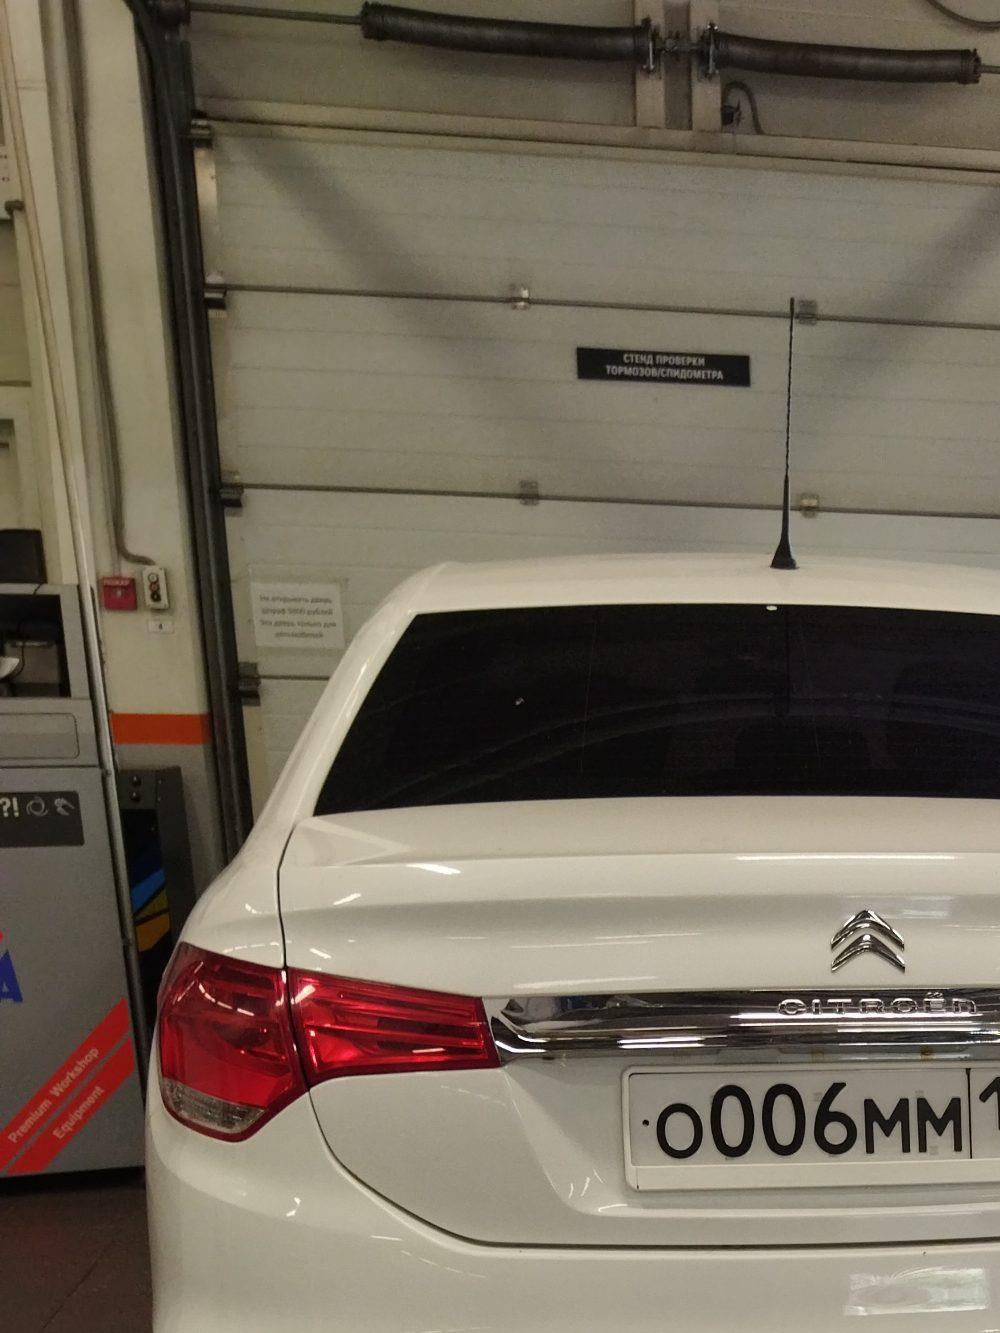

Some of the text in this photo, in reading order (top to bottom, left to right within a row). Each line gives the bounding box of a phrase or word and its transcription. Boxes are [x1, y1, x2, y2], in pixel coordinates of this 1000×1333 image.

[606, 365, 724, 380] ТОРМОЗОВ/СПИДОМЕТРА
[623, 353, 706, 366] СТЕНД ПРОВЕРКИ
[8, 1048, 99, 1143] Premium Workshop
[52, 1086, 104, 1139] Equipment
